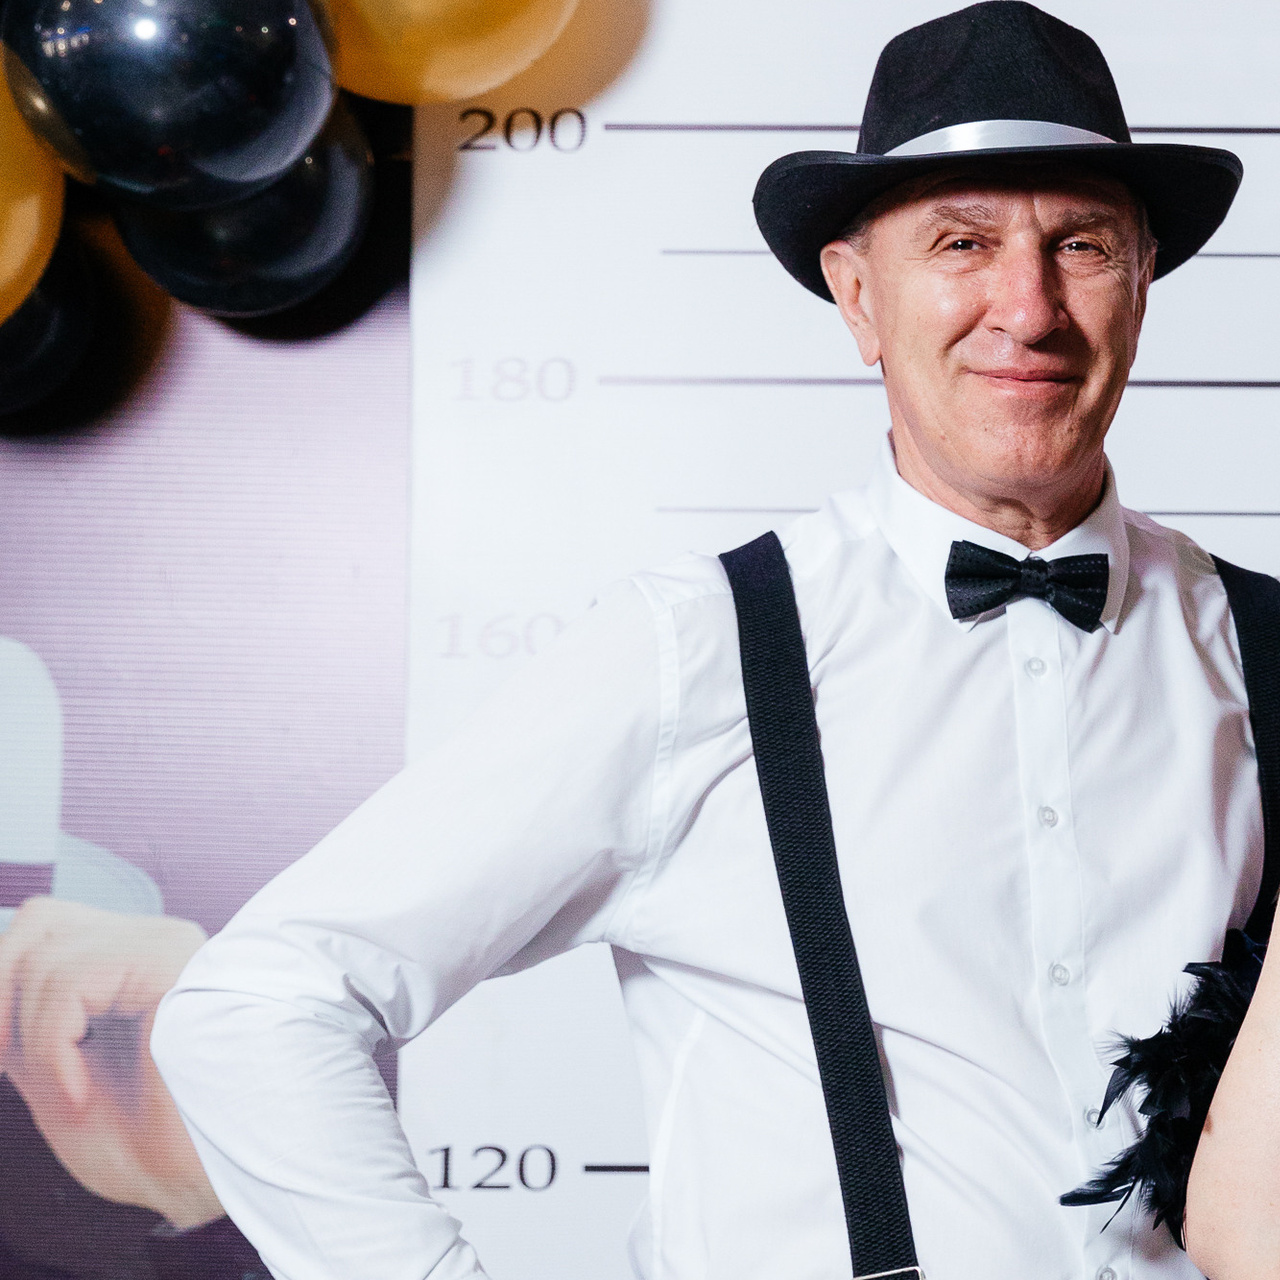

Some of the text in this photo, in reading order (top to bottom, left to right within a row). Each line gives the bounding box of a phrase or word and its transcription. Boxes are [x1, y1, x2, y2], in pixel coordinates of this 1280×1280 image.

[457, 106, 588, 154] 200
[447, 356, 577, 403] 180
[428, 1144, 557, 1191] 120
